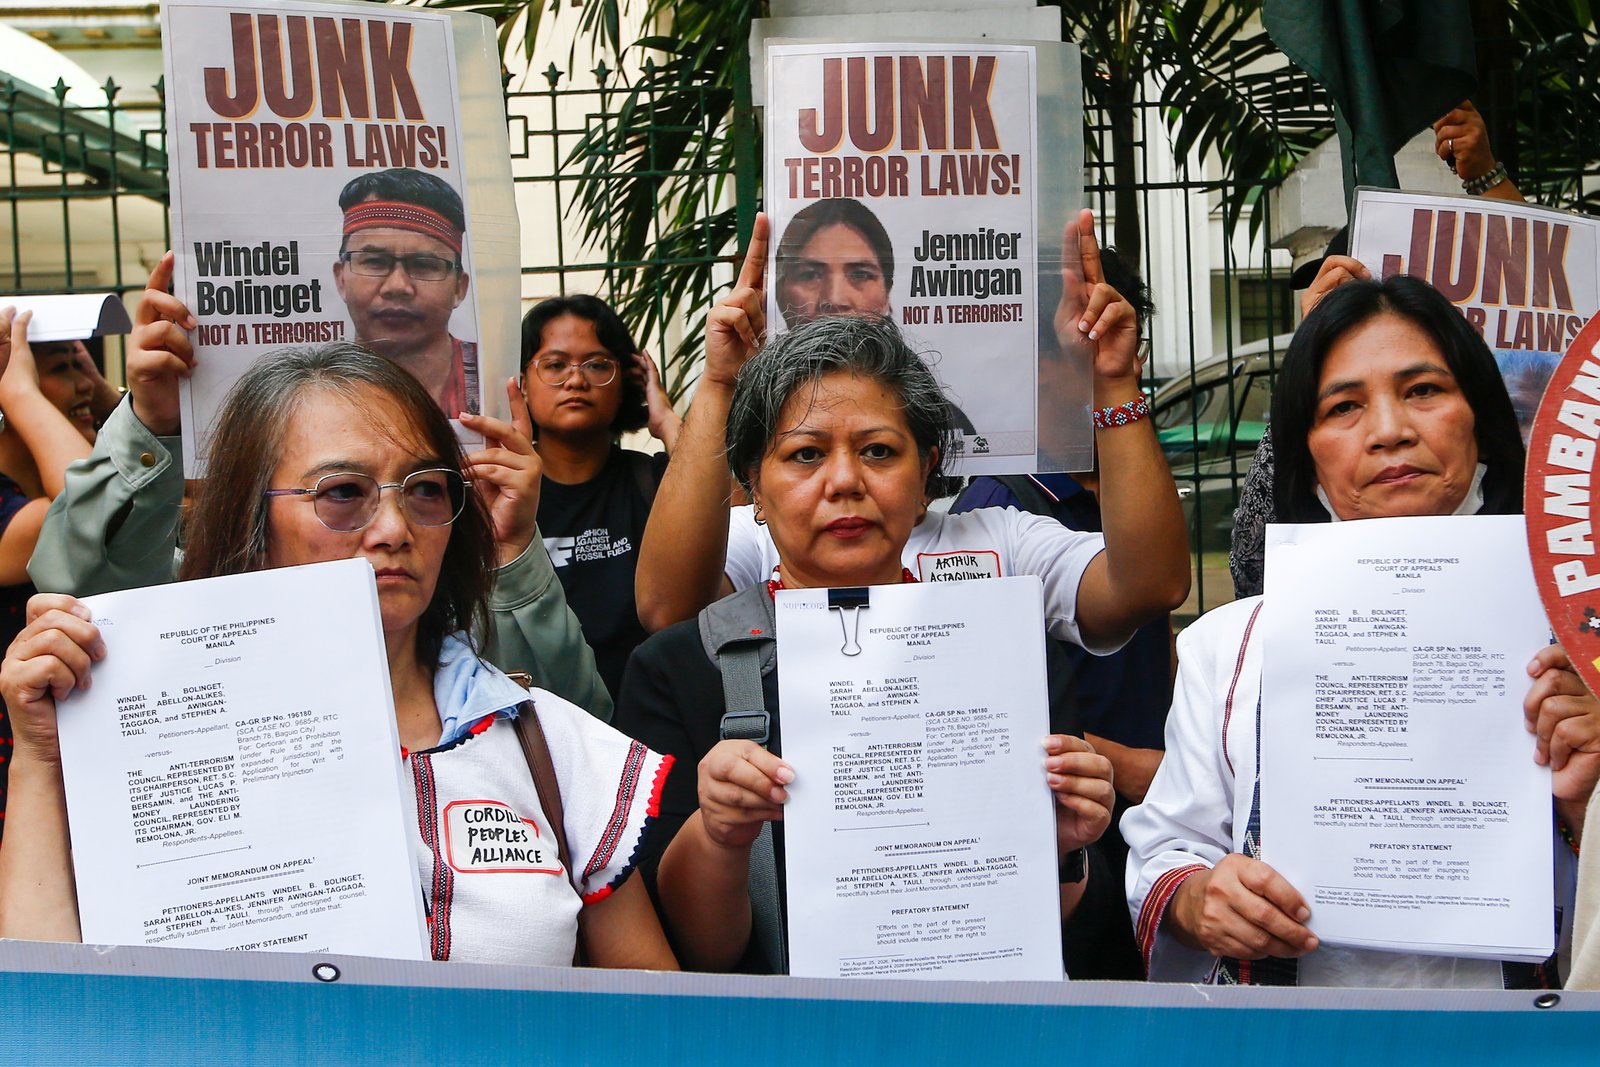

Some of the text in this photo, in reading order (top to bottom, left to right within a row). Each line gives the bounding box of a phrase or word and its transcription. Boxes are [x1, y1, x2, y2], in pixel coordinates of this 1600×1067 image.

[203, 12, 427, 122] JUNK
[798, 55, 1001, 154] JUNK
[190, 123, 450, 169] TERROR LAWS!
[784, 154, 1021, 199] TERROR LAWS!
[914, 227, 1021, 262] Jennifer
[194, 240, 299, 277] Windel
[1382, 208, 1576, 313] JUNK
[910, 263, 1022, 300] Awingan
[196, 279, 322, 318] Bolinget
[903, 303, 1023, 325] NOT A TERRORIST!
[198, 321, 345, 346] NOT A TERRORIST!
[1495, 309, 1590, 353] LAWS
[1543, 343, 1600, 598] PAMBAN
[576, 528, 608, 542] FSHION
[575, 537, 628, 554] FASCISM AND
[576, 543, 632, 562] FOSSIL FUELS
[936, 554, 979, 570] ARTHUR
[159, 617, 275, 639] REPUBLIC OF THE PHILIPPINES
[180, 634, 207, 645] COURT
[221, 628, 257, 639] APPEALS
[869, 626, 901, 634] REPUBLIC
[927, 622, 965, 630] PHILIPPINES
[920, 630, 950, 638] APPEALS
[205, 639, 235, 649] MANILA
[214, 655, 241, 665] Division
[116, 694, 147, 704] WINDEL
[117, 702, 145, 712] SARAH
[881, 698, 911, 706] STEPHEN
[119, 709, 157, 721] JENNIFER
[164, 714, 178, 722] and
[180, 708, 217, 719] STEPHEN
[234, 717, 260, 727] CA-GR
[287, 709, 312, 719] 196180
[867, 741, 922, 750] ANTI-TERRORISM
[126, 754, 234, 777] THE ANTI-TERRORISM
[132, 795, 240, 819] MONEY LAUNDERING
[468, 827, 528, 847] PEOPLES
[894, 841, 941, 850] MEMORANDUM
[471, 847, 542, 865] ALLIANCE
[187, 875, 209, 885] JOINT
[211, 865, 268, 881] MEMORANDUM
[851, 862, 937, 874] PETITIONERS-APPELLANTS
[943, 860, 968, 868] WINDEL
[921, 868, 952, 877] JENNIFER
[162, 890, 265, 915] PETITIONERS-APPELLANTS
[272, 884, 302, 895] WINDEL
[891, 903, 969, 915] PREFATORY STATEMENT
[143, 916, 171, 927] SARAH
[247, 896, 284, 908] JENNIFER
